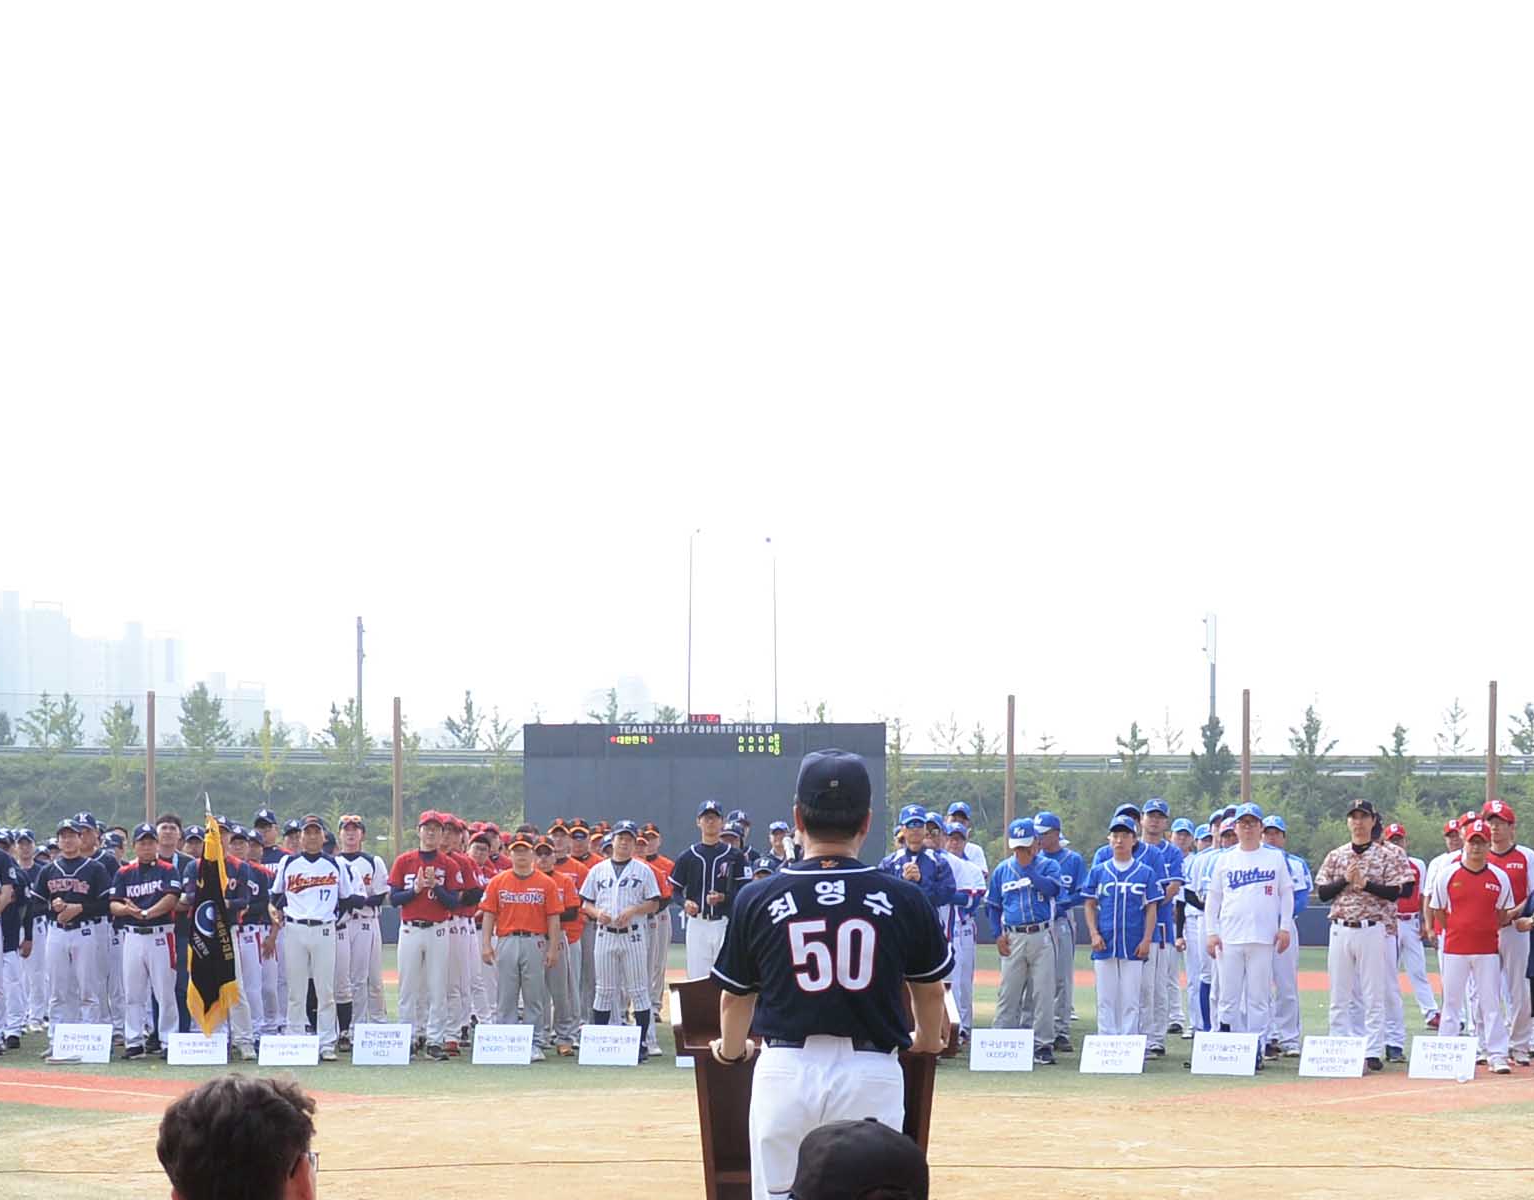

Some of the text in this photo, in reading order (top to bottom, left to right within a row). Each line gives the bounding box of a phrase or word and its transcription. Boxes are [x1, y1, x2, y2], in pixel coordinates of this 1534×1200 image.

[619, 725, 647, 734] TEAM
[1227, 867, 1276, 890] Withus
[319, 889, 331, 901] 17
[767, 879, 894, 924] 최영수
[787, 917, 877, 992] 50
